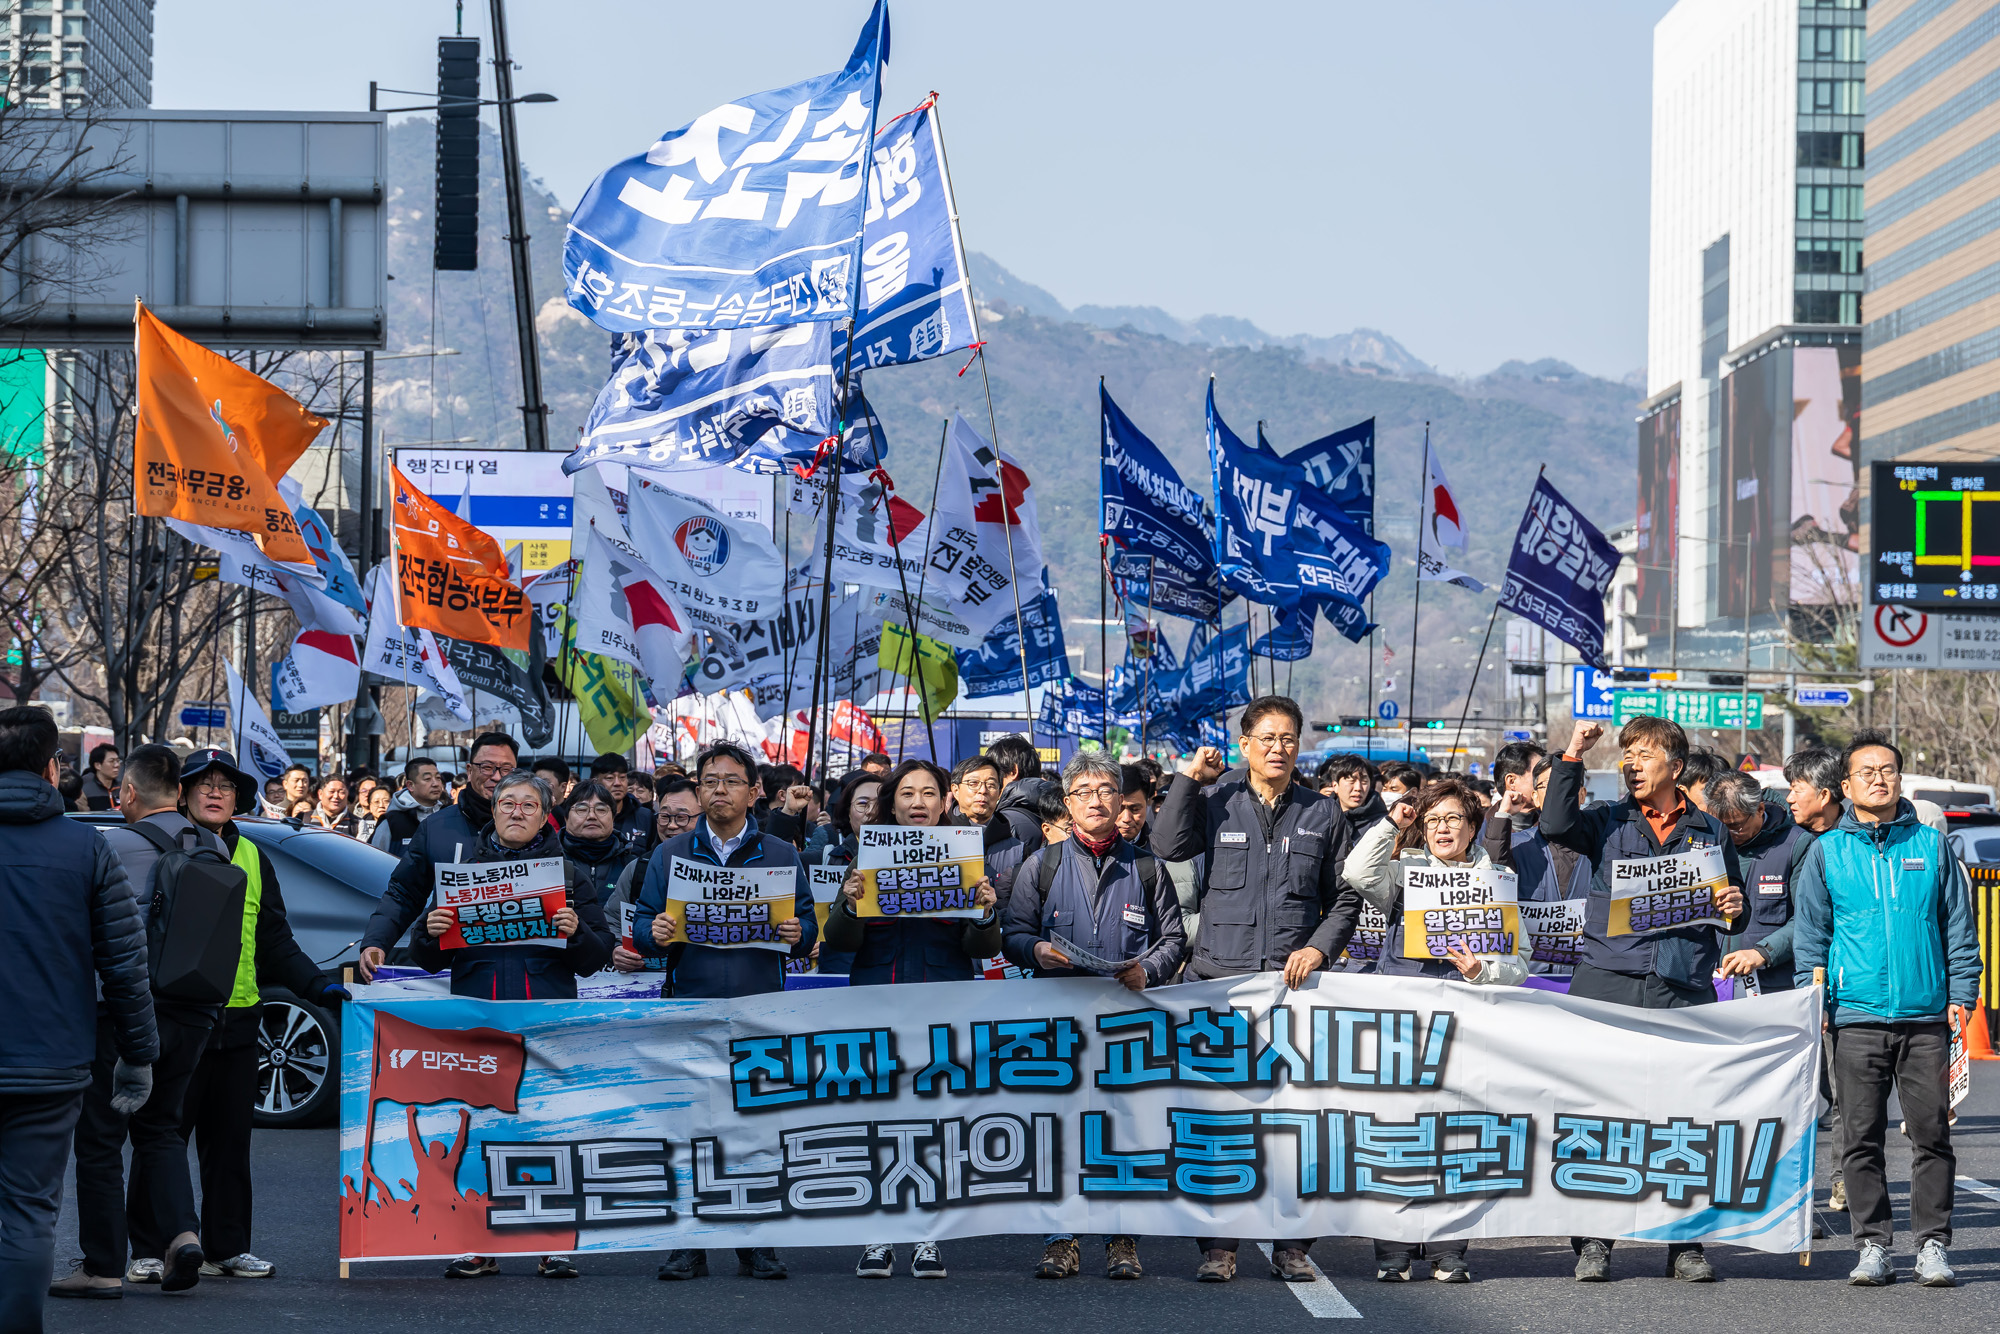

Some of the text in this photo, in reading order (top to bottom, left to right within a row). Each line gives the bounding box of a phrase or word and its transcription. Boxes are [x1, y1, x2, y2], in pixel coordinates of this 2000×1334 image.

[406, 458, 499, 475] 행진대열
[1950, 477, 1985, 491] 광화문
[1879, 551, 1914, 566] 서대문
[242, 563, 279, 587] 민주노
[1877, 583, 1918, 599] 광화문
[452, 665, 491, 688] Korean
[279, 712, 310, 725] 6701
[862, 829, 925, 847] 진짜사장
[892, 843, 950, 865] 나와라!
[440, 863, 529, 887] 모든 노동자의
[673, 861, 736, 886] 진짜사장
[813, 869, 844, 885] 진짜
[875, 865, 962, 892] 원청교섭
[1408, 870, 1471, 889] 진짜사장
[1615, 858, 1678, 880] 진짜사장
[1647, 866, 1702, 893] 나와라!
[445, 883, 515, 905] 노동기본권
[702, 883, 760, 901] 나와라!
[877, 887, 977, 916] 쟁취하자!
[1439, 886, 1494, 906] 나와라!
[1630, 886, 1712, 915] 원청교섭
[457, 896, 544, 925] 투쟁으로
[684, 902, 770, 924] 원청교섭
[1423, 908, 1503, 933] 원청교섭
[461, 914, 560, 946] 쟁취하자!
[684, 922, 782, 945] 쟁취하자!
[1538, 916, 1584, 934] 나와라!
[1425, 931, 1514, 958] 쟁취하자!
[421, 1049, 498, 1076] 민주노총
[730, 1026, 900, 1112] 진짜
[913, 1017, 1081, 1095] 사장
[481, 1107, 1783, 1232] 모든 노동자의 노동기본권 쟁취!
